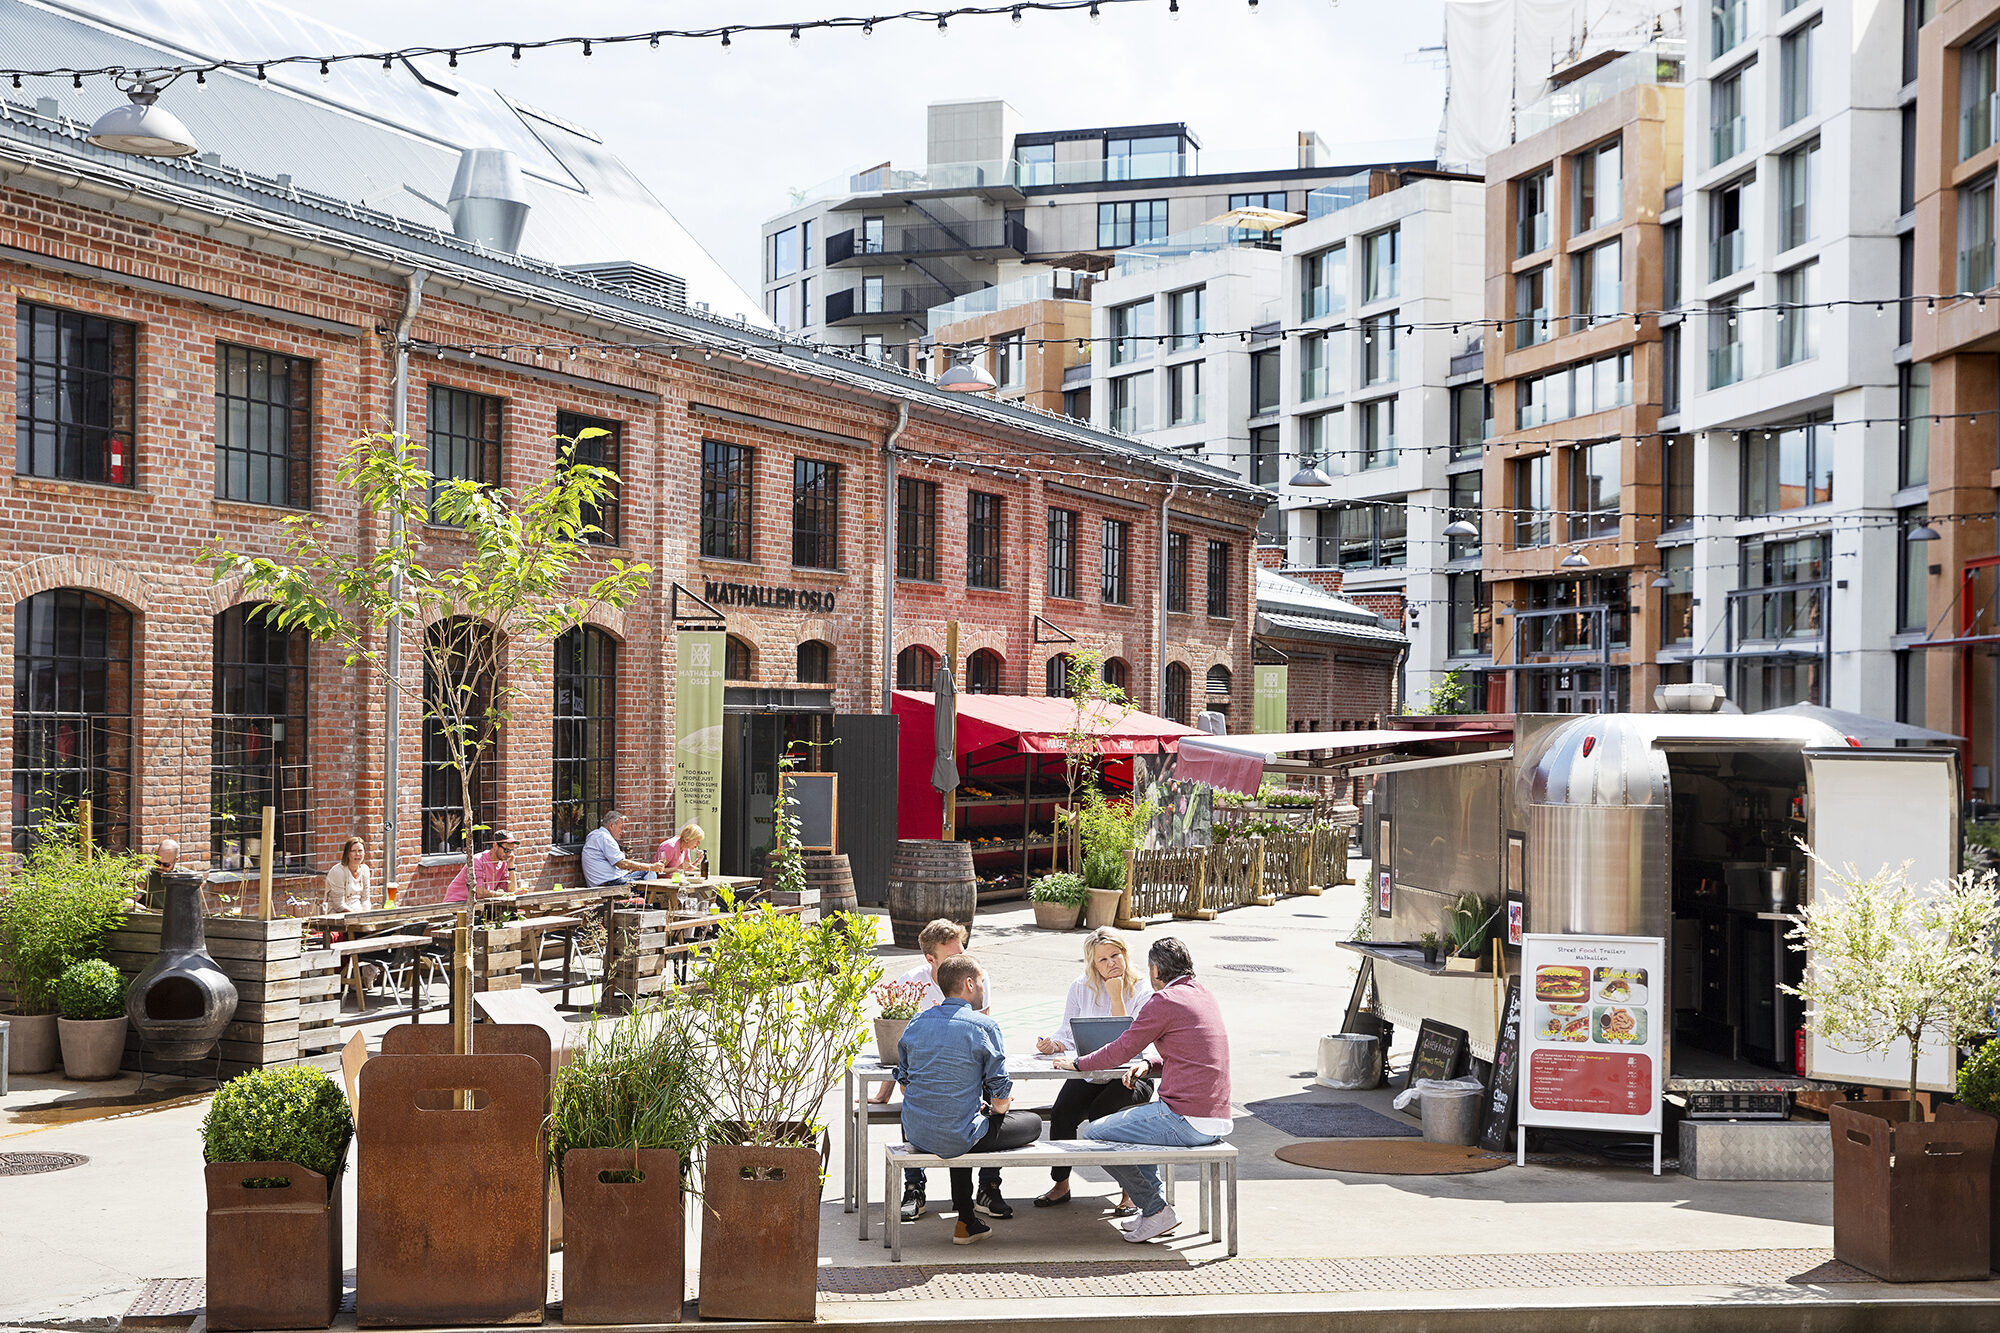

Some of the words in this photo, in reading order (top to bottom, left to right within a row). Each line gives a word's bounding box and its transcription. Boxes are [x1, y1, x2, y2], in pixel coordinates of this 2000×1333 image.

[704, 580, 796, 609] MATHALLEN
[799, 589, 835, 613] OSLO
[678, 670, 722, 678] MATHALLEN
[1560, 676, 1570, 688] 16
[1119, 740, 1134, 750] FRUKT
[1544, 969, 1583, 977] BURGERS
[1599, 970, 1642, 979] SHAWARMA
[1601, 1032, 1638, 1041] CHURROS
